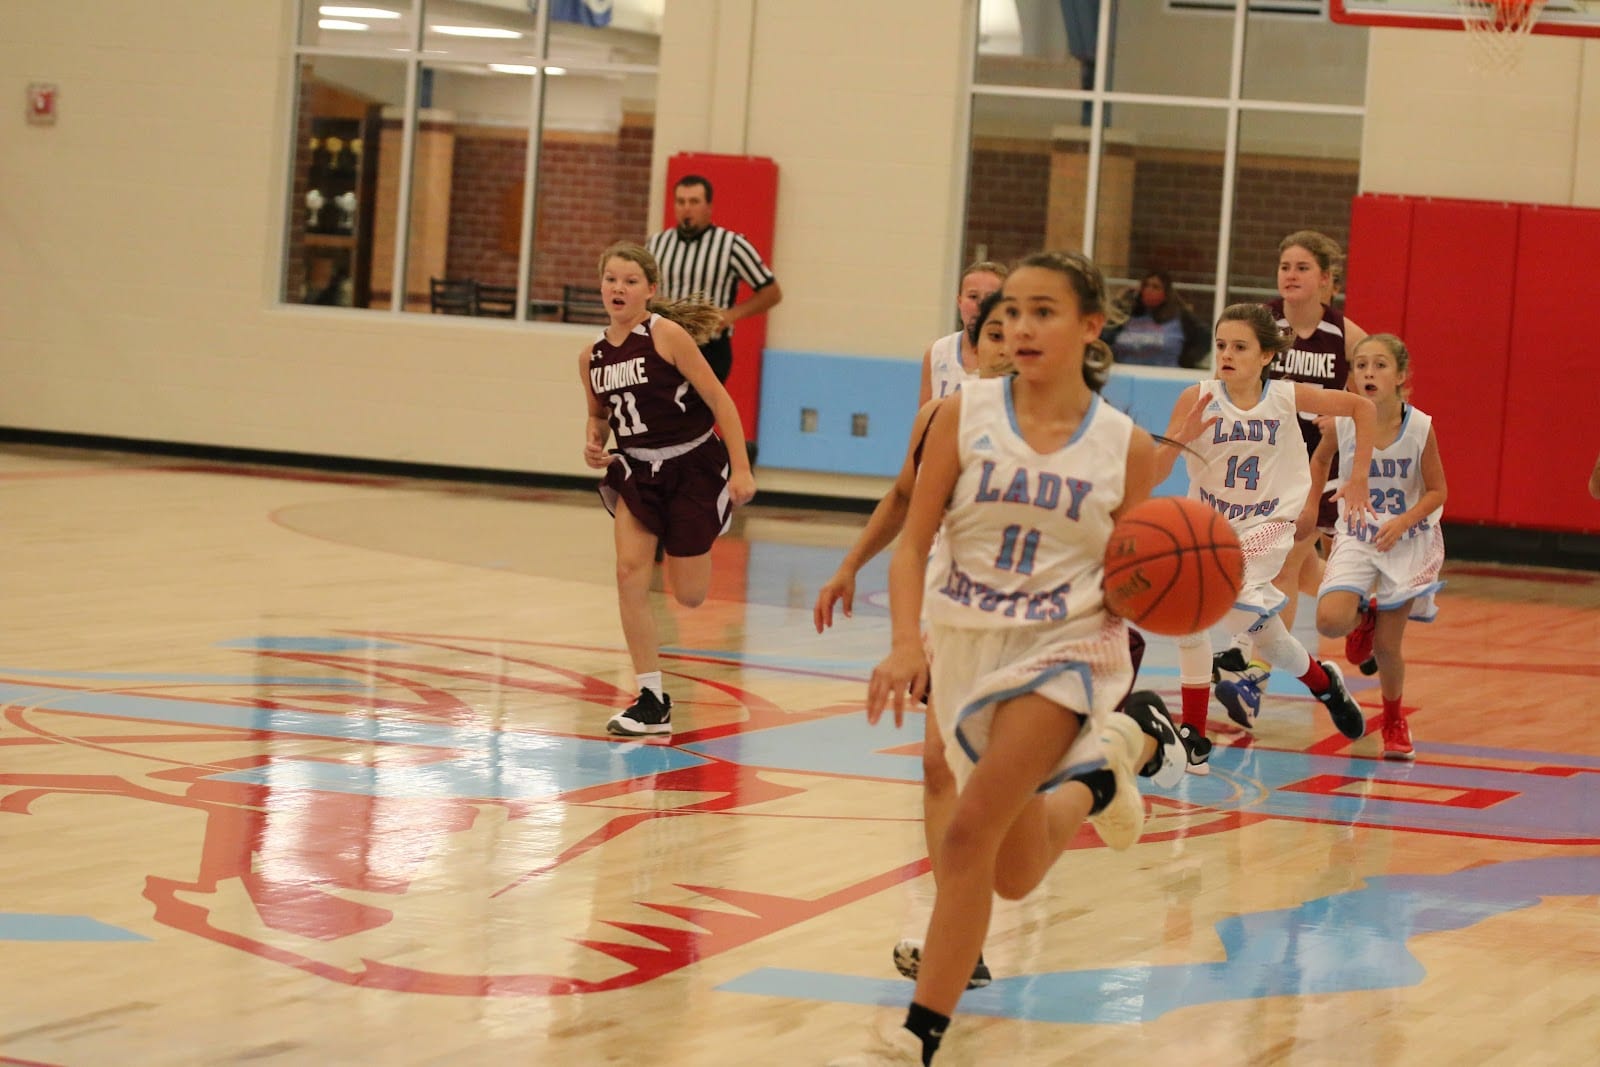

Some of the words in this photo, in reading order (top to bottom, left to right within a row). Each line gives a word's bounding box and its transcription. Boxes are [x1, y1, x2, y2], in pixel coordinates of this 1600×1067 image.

[590, 357, 649, 394] KLONDIKE
[1271, 348, 1336, 378] LONDIKE
[1213, 418, 1280, 446] LADY
[1224, 455, 1260, 490] 14
[1368, 457, 1412, 478] ADY
[975, 460, 1093, 522] LADY
[1366, 487, 1407, 515] 23
[994, 524, 1041, 576] 11
